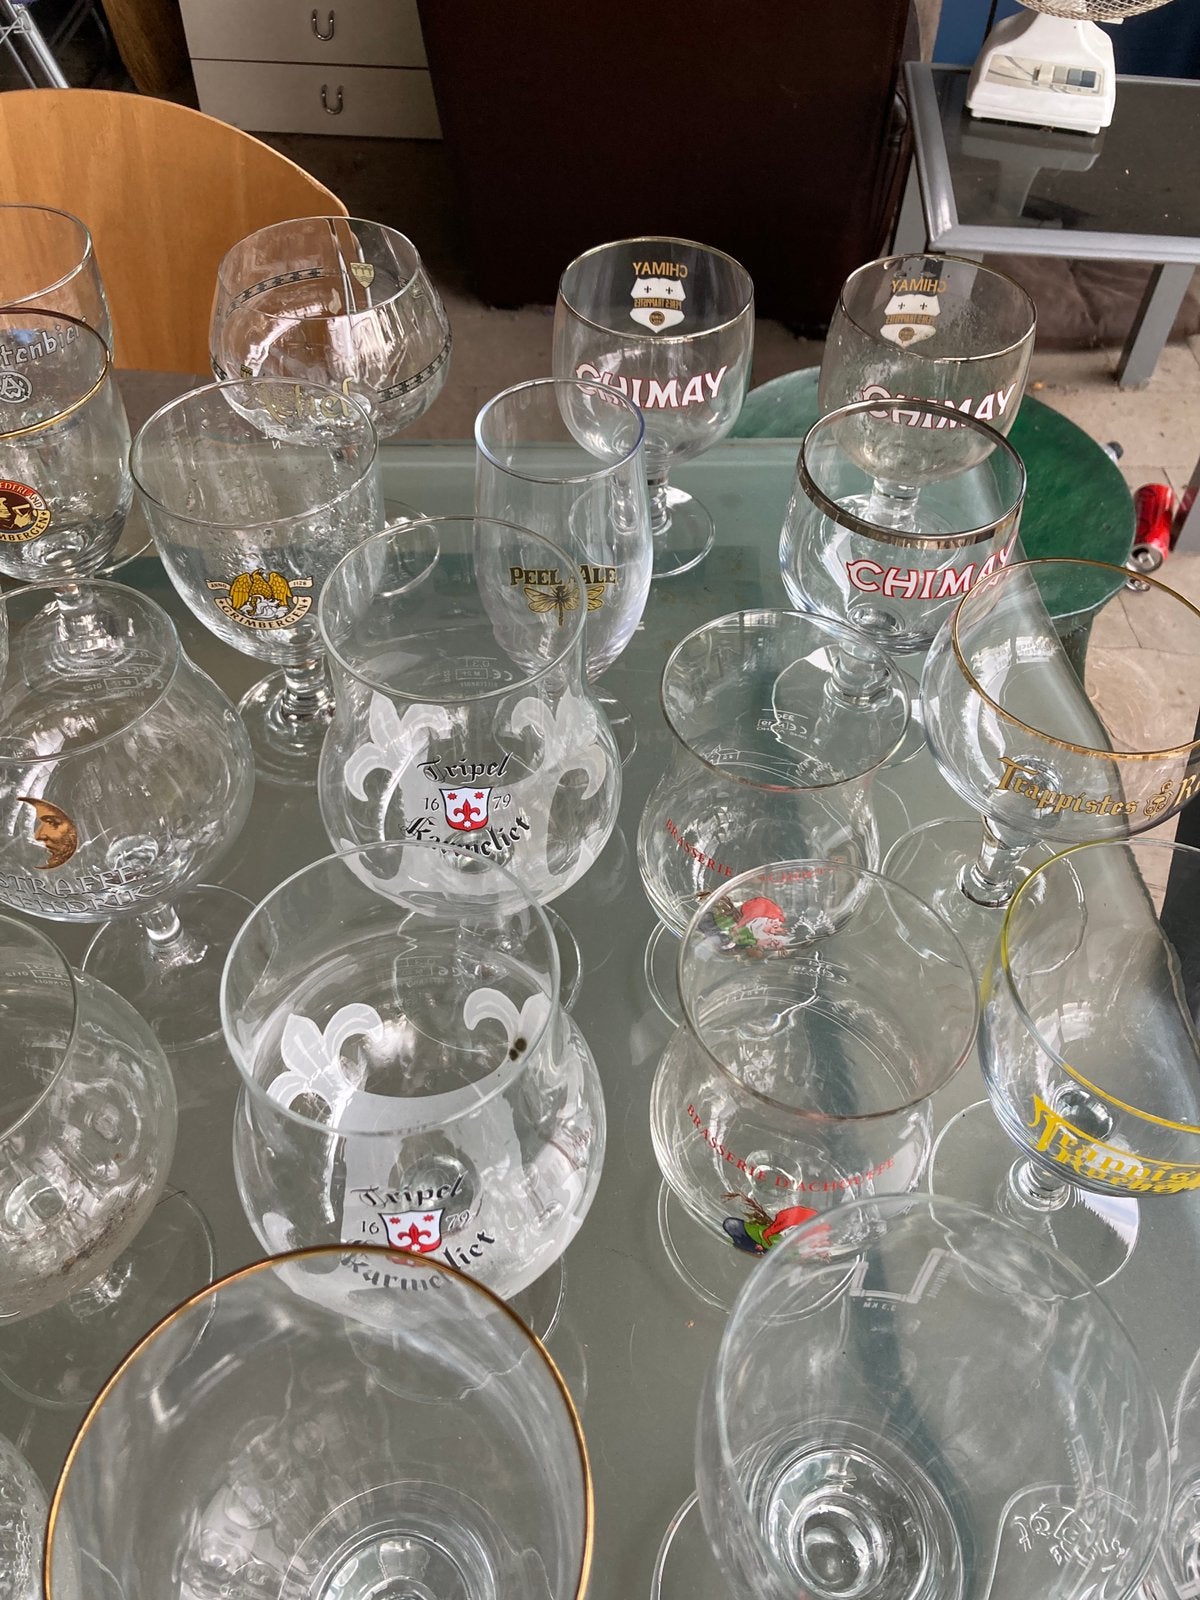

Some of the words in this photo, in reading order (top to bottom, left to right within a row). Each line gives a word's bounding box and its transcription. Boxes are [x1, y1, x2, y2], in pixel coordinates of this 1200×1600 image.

[576, 361, 728, 410] CHIMAY
[861, 381, 1018, 430] CHIMAY
[509, 566, 563, 587] PEEL
[579, 564, 617, 585] ALE
[846, 528, 1019, 600] CHIMAY
[221, 603, 309, 629] GRIMBERGEN
[416, 752, 513, 784] Tripel
[995, 756, 1139, 817] Trappistes
[424, 796, 441, 812] 16
[492, 793, 513, 812] 79
[665, 817, 734, 878] BRASSERIE
[687, 1103, 767, 1182] BRASSERIE
[350, 1170, 468, 1208] Tripel
[360, 1220, 381, 1236] 16
